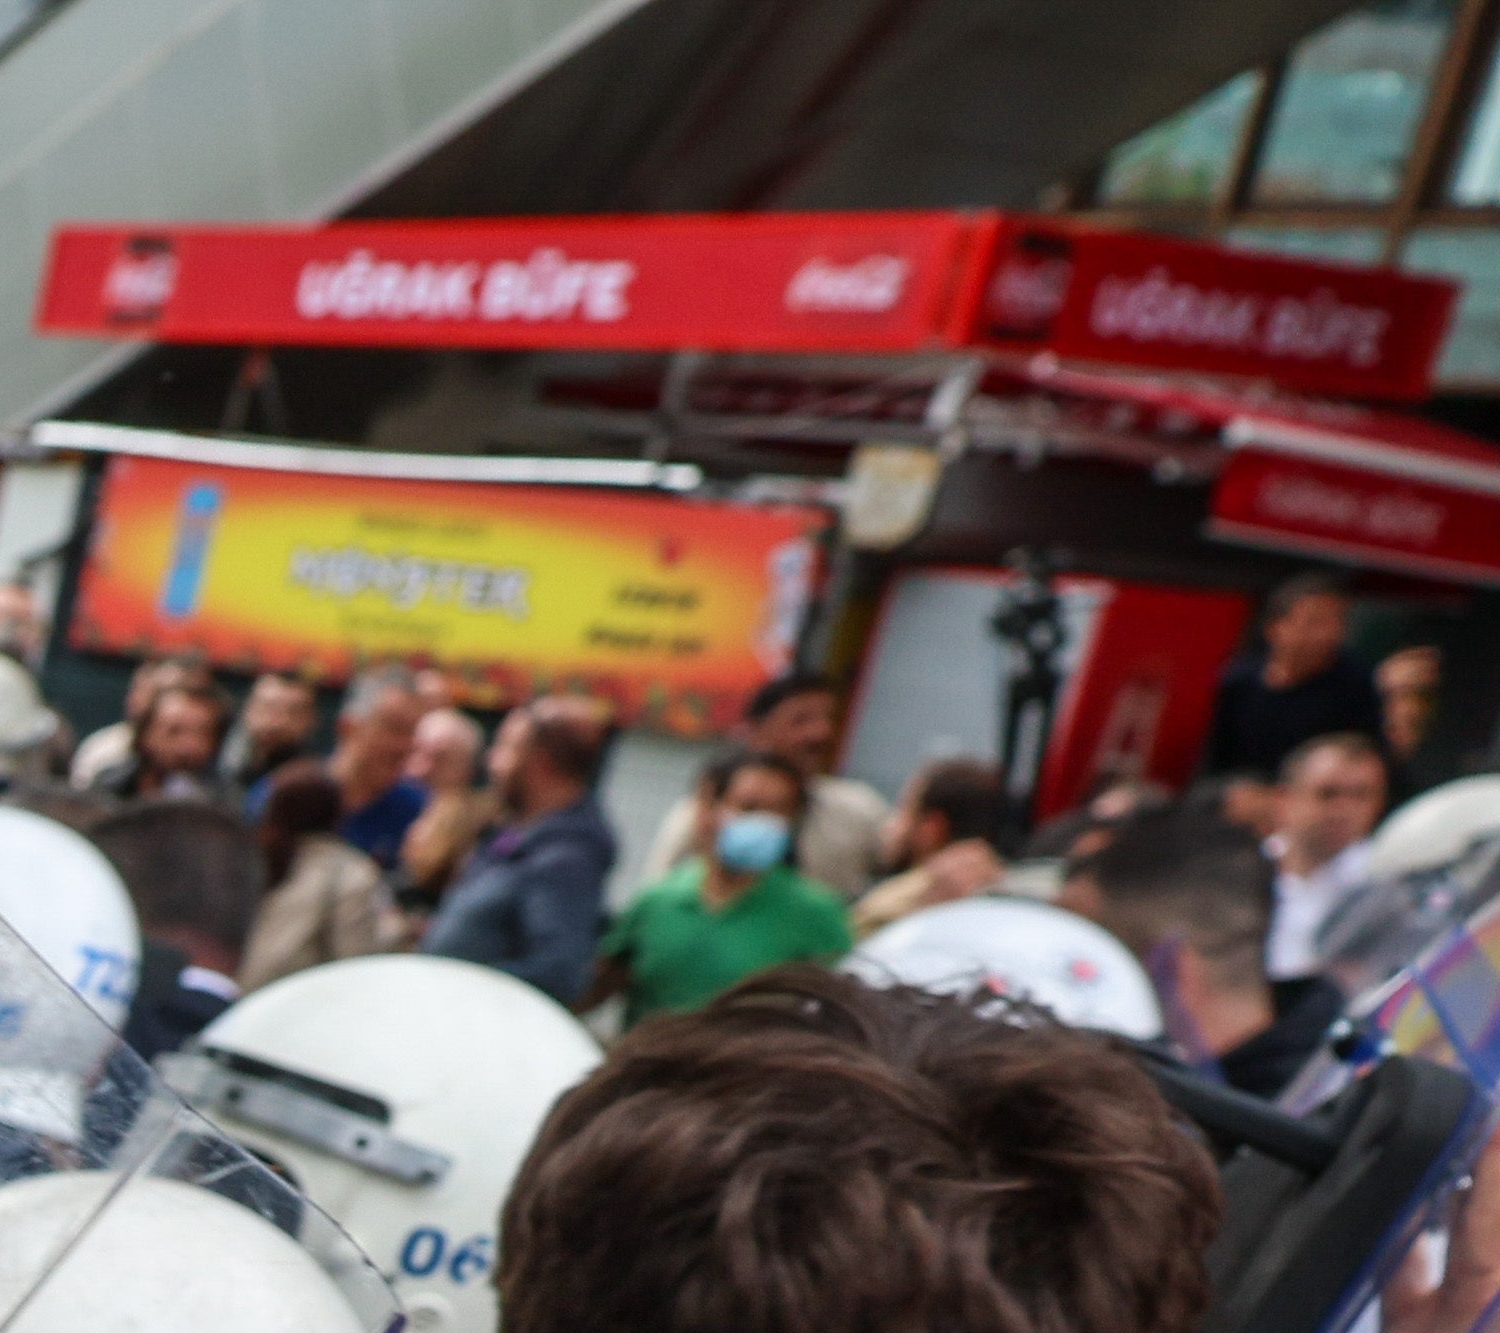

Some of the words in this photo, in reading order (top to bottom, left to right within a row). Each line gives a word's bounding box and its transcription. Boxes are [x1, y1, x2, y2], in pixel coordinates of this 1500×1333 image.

[299, 251, 477, 317] UĞRAK
[483, 248, 635, 320] BÜFE
[401, 1224, 492, 1286] 06
